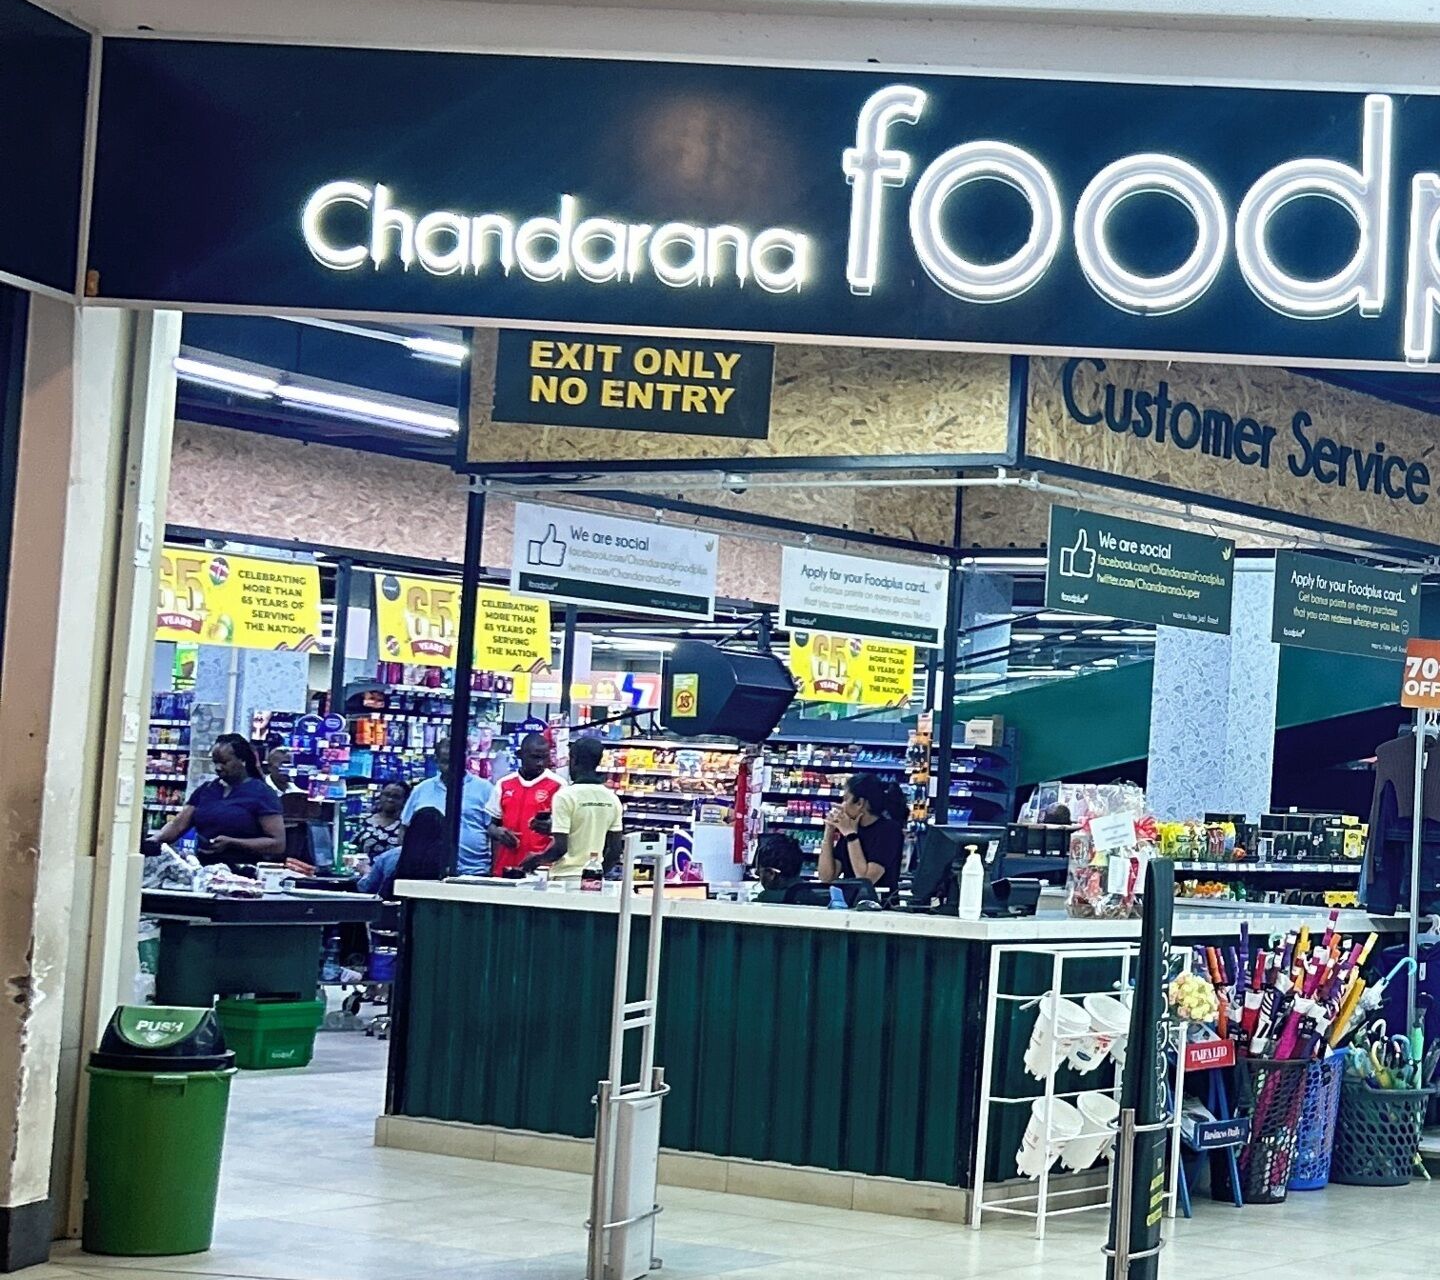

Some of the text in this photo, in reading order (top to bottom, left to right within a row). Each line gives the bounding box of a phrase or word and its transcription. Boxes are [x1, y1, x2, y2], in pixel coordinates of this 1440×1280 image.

[302, 181, 808, 293] Chandarana
[530, 340, 742, 380] EXIT ONLY
[530, 375, 736, 415] NO ENTRY
[1062, 357, 1430, 505] Customer Service
[570, 525, 649, 551] We are social
[1098, 530, 1171, 560] We are social
[238, 570, 306, 585] CELEBRATING
[801, 564, 828, 580] Apply
[829, 568, 842, 580] for
[844, 572, 863, 584] your
[864, 573, 903, 589] Foodplus
[243, 584, 302, 597] MORE THAN
[1290, 570, 1315, 589] Apply
[1316, 575, 1327, 589] for
[1329, 580, 1346, 593] your
[1347, 580, 1382, 599] Foodplus
[241, 596, 304, 609] 65 YEARS OF
[482, 600, 539, 612] CELEBRATING
[161, 614, 193, 628] YEARS
[252, 610, 295, 622] SERVING
[485, 612, 535, 623] MORE THAN
[244, 621, 306, 634] THE NATION
[496, 624, 524, 634] YEARS
[493, 635, 529, 646] SERVING
[486, 646, 538, 657] THE NATION
[136, 1020, 184, 1033] PUSH
[1190, 1047, 1211, 1062] TAIFA
